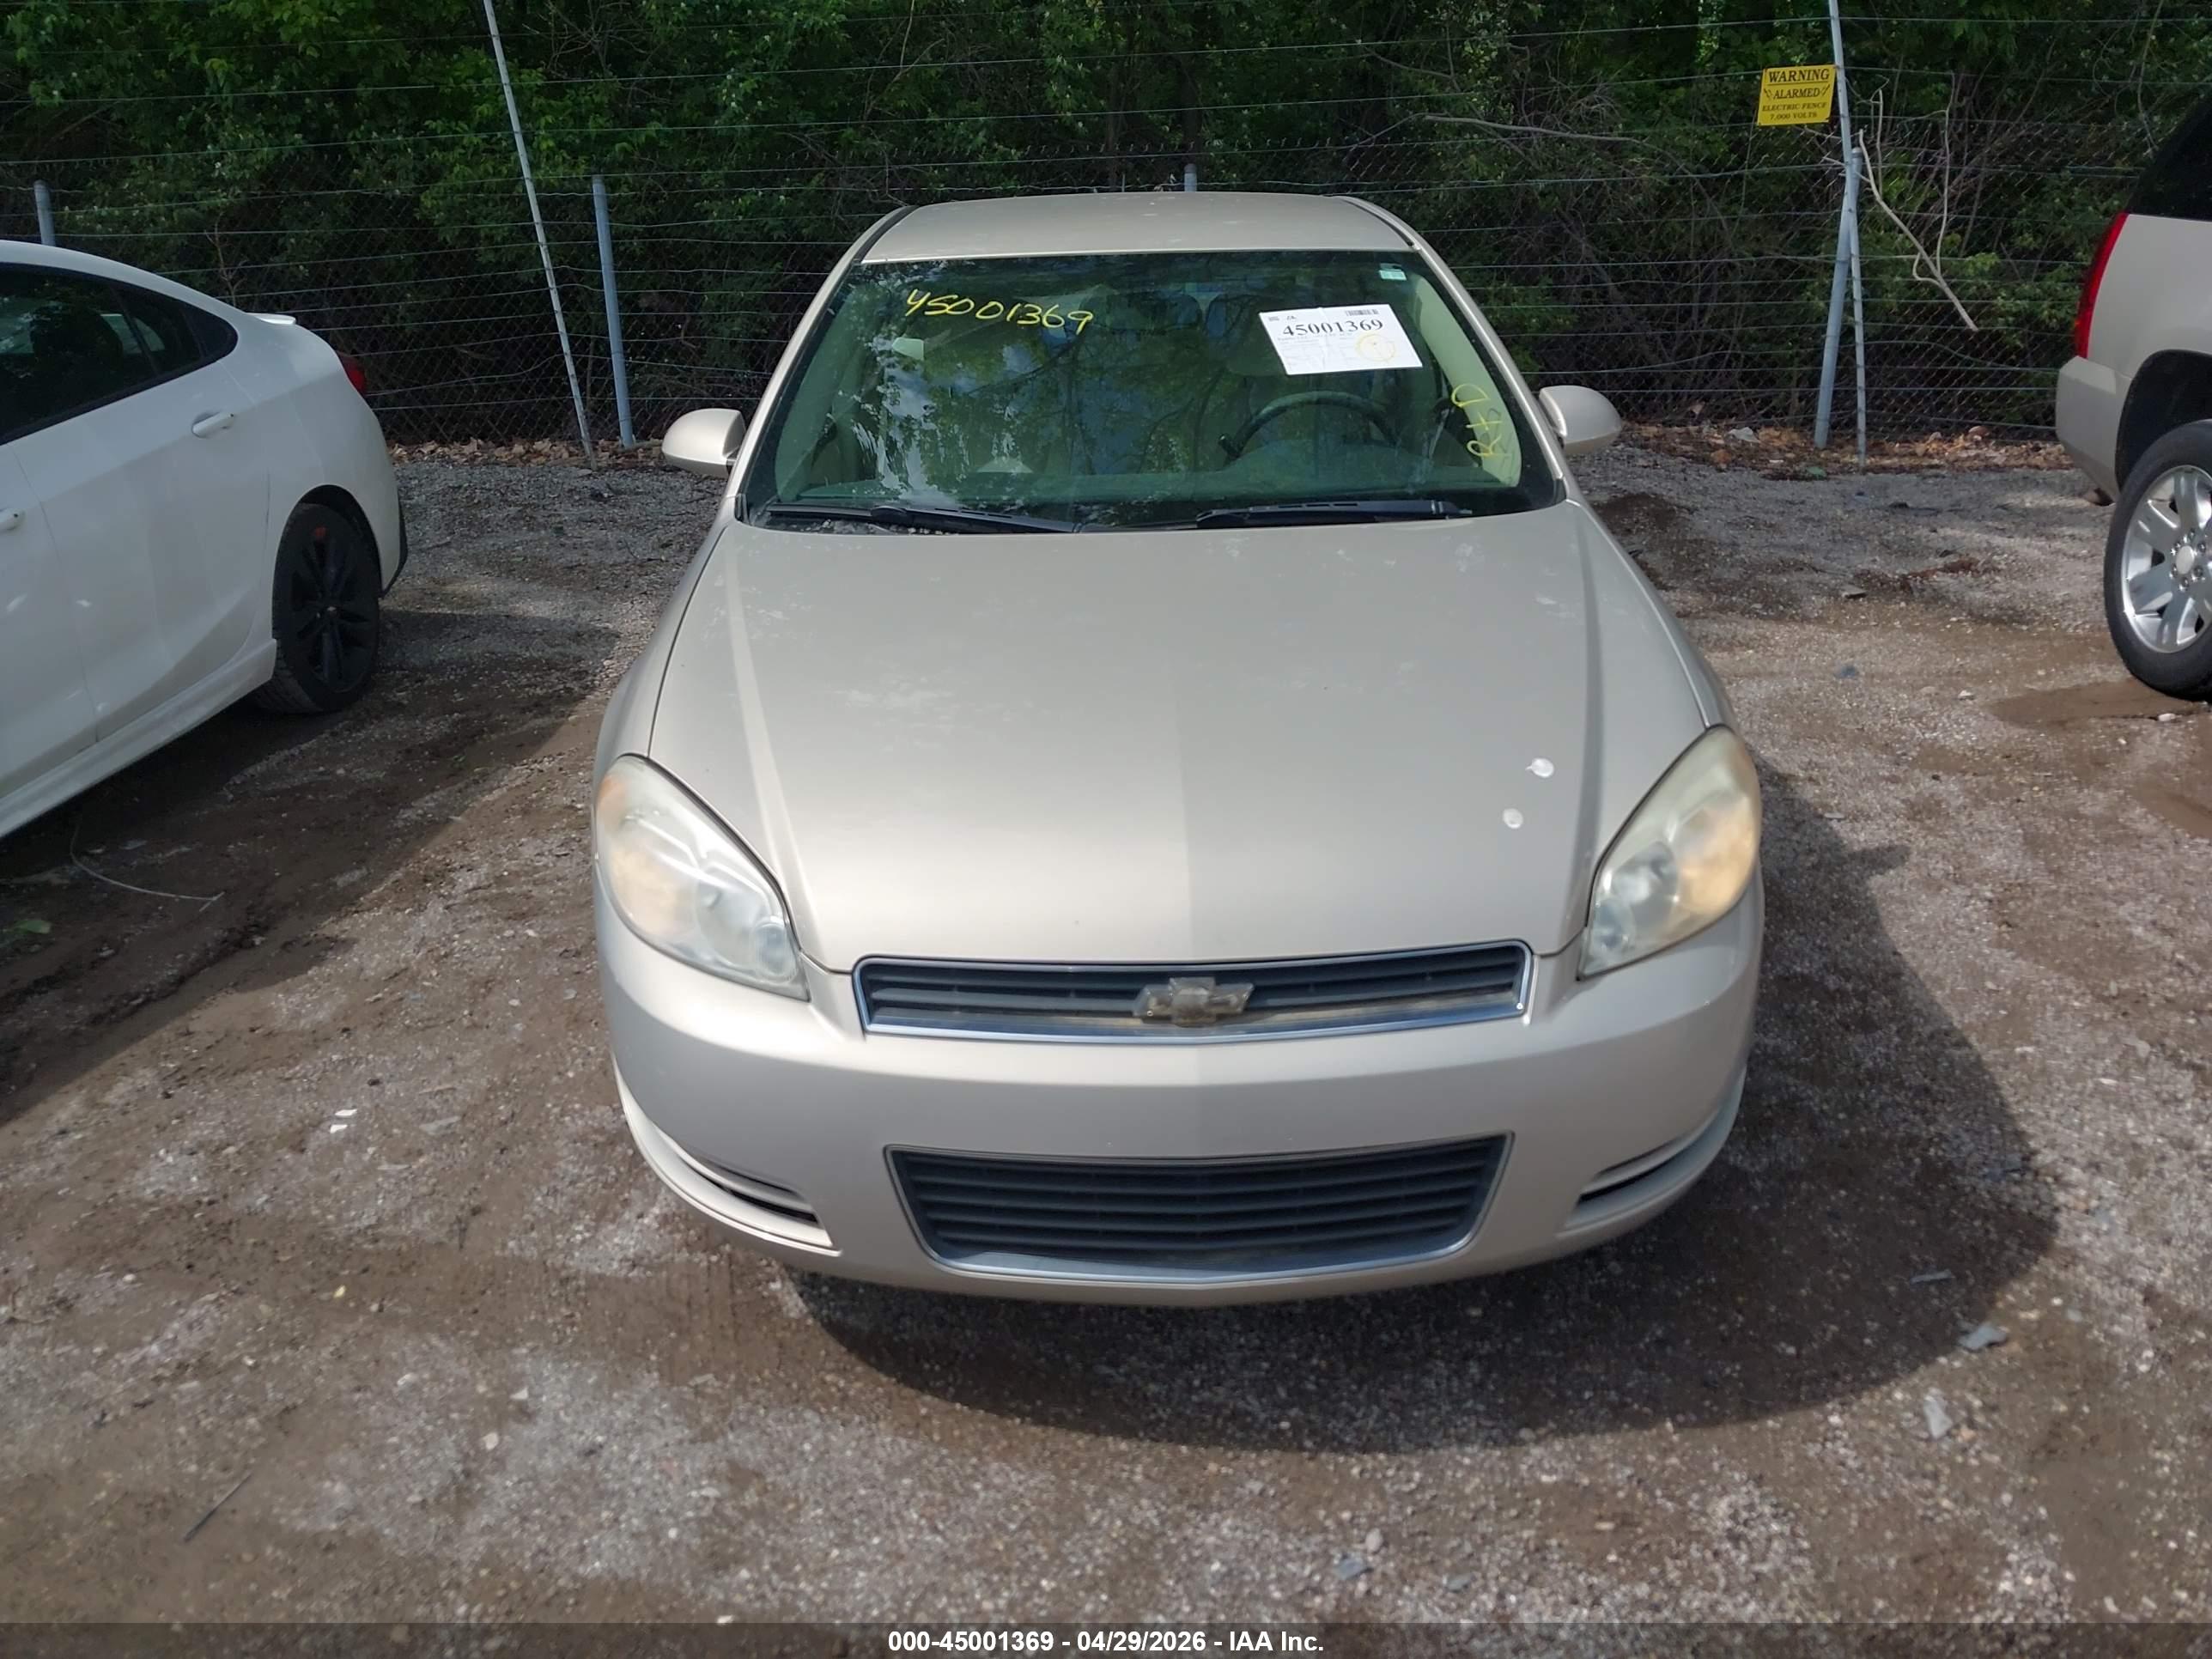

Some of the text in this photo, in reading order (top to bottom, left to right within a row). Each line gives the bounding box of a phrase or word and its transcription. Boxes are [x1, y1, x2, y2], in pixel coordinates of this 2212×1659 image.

[1769, 69, 1830, 83] WARNING
[1773, 88, 1820, 100] ALARMED
[1762, 103, 1800, 112] ELECTRIC
[1282, 319, 1383, 336] 45001369
